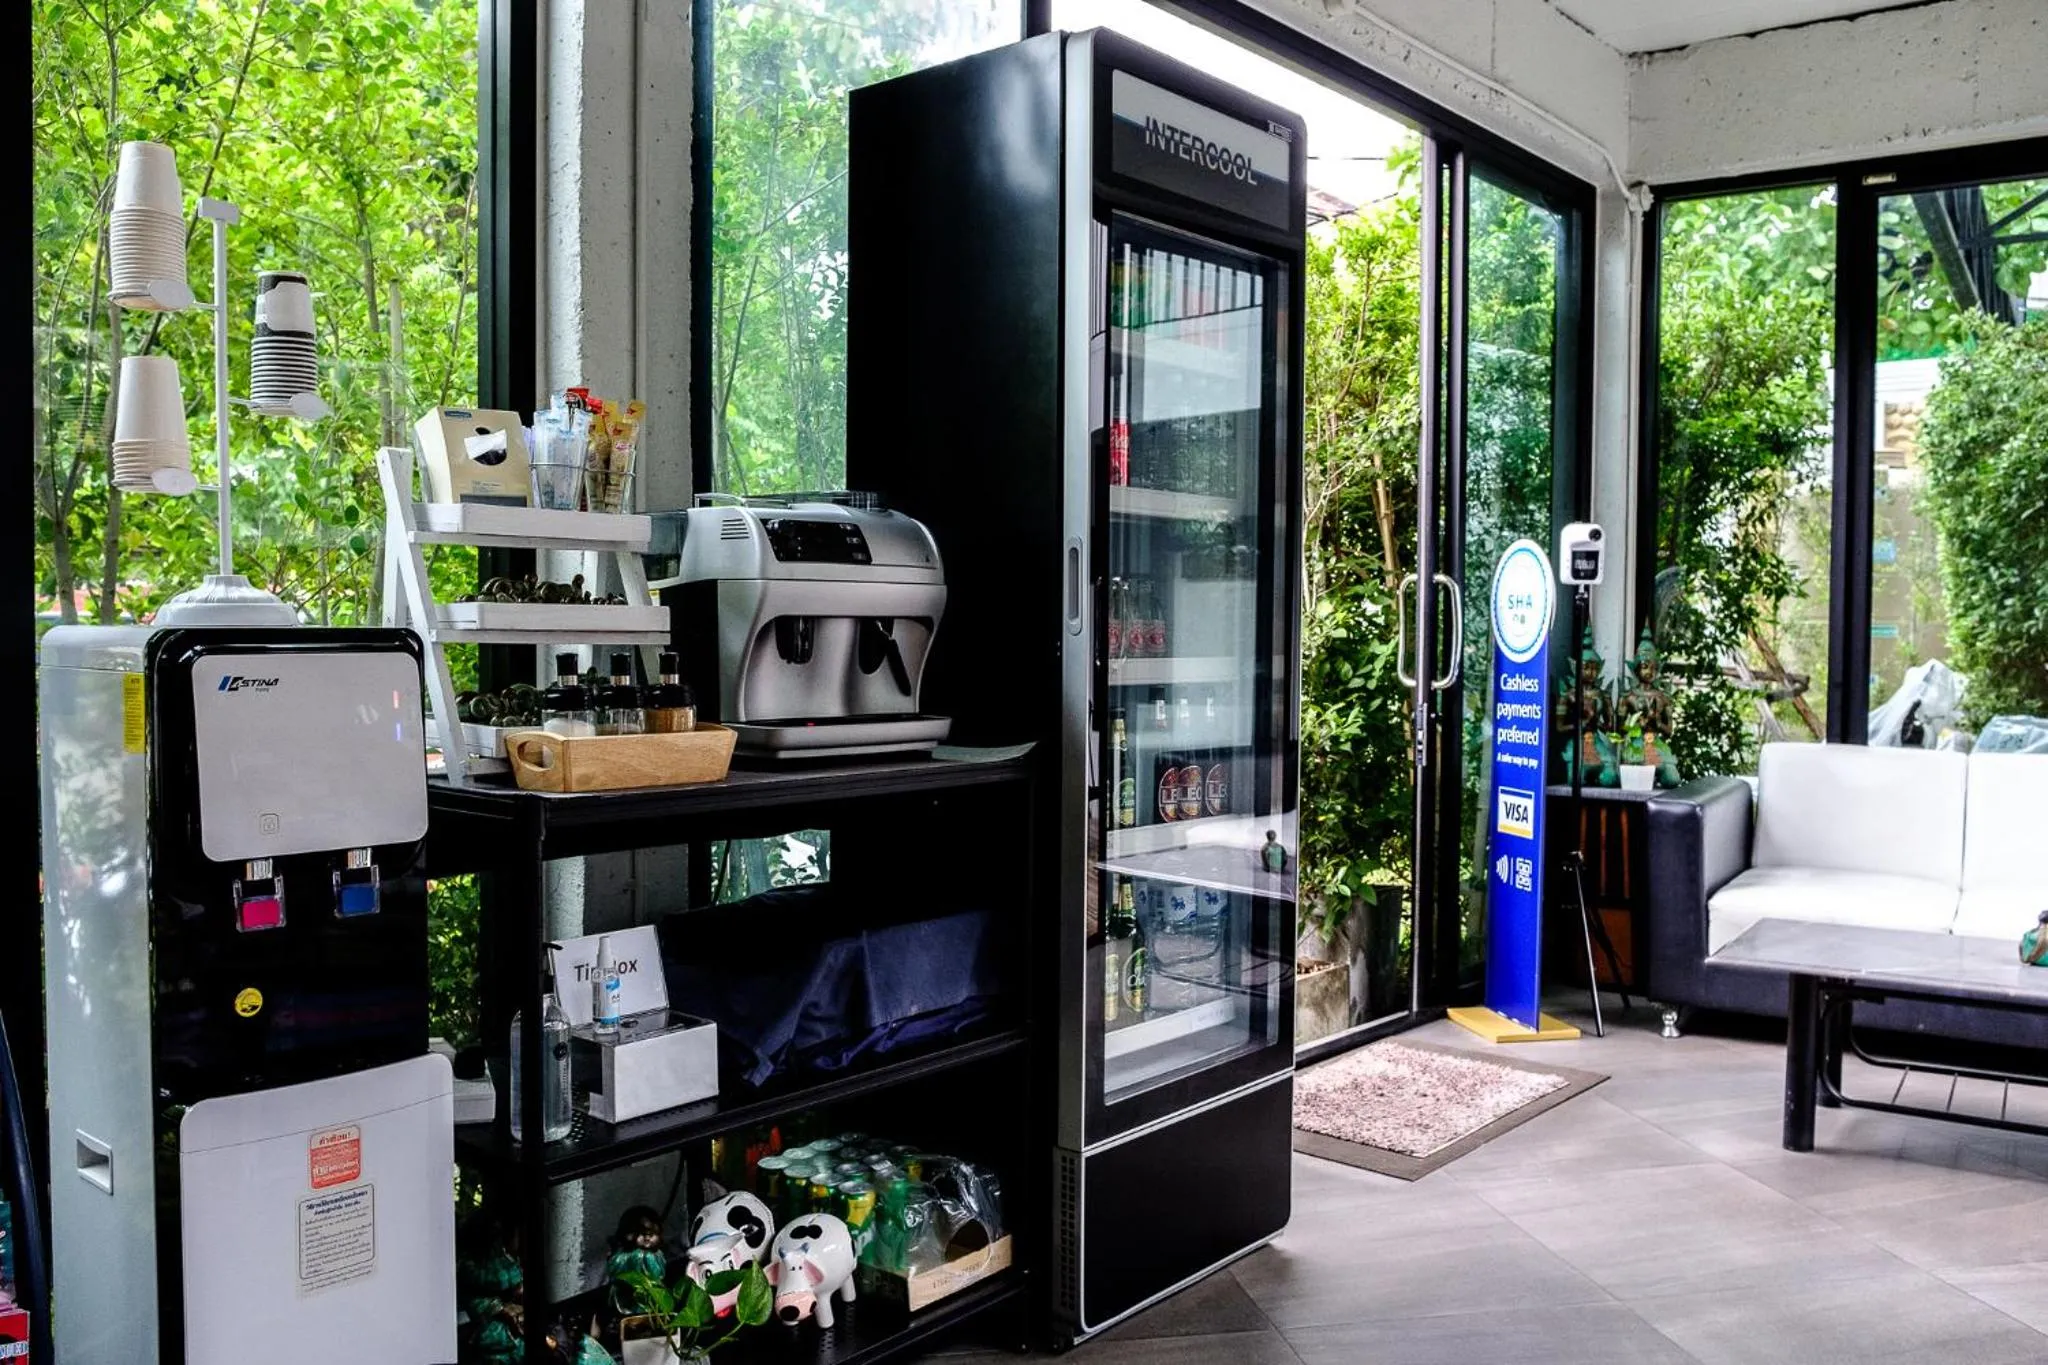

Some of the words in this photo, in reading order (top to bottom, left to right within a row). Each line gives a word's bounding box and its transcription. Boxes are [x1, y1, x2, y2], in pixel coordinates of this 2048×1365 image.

[1144, 116, 1258, 186] INTERCOOL
[1508, 593, 1532, 609] SHA
[1501, 673, 1539, 692] Cashless
[1497, 703, 1541, 720] payments
[1497, 725, 1540, 746] preferred
[1504, 801, 1529, 824] VISA
[613, 959, 638, 975] ox
